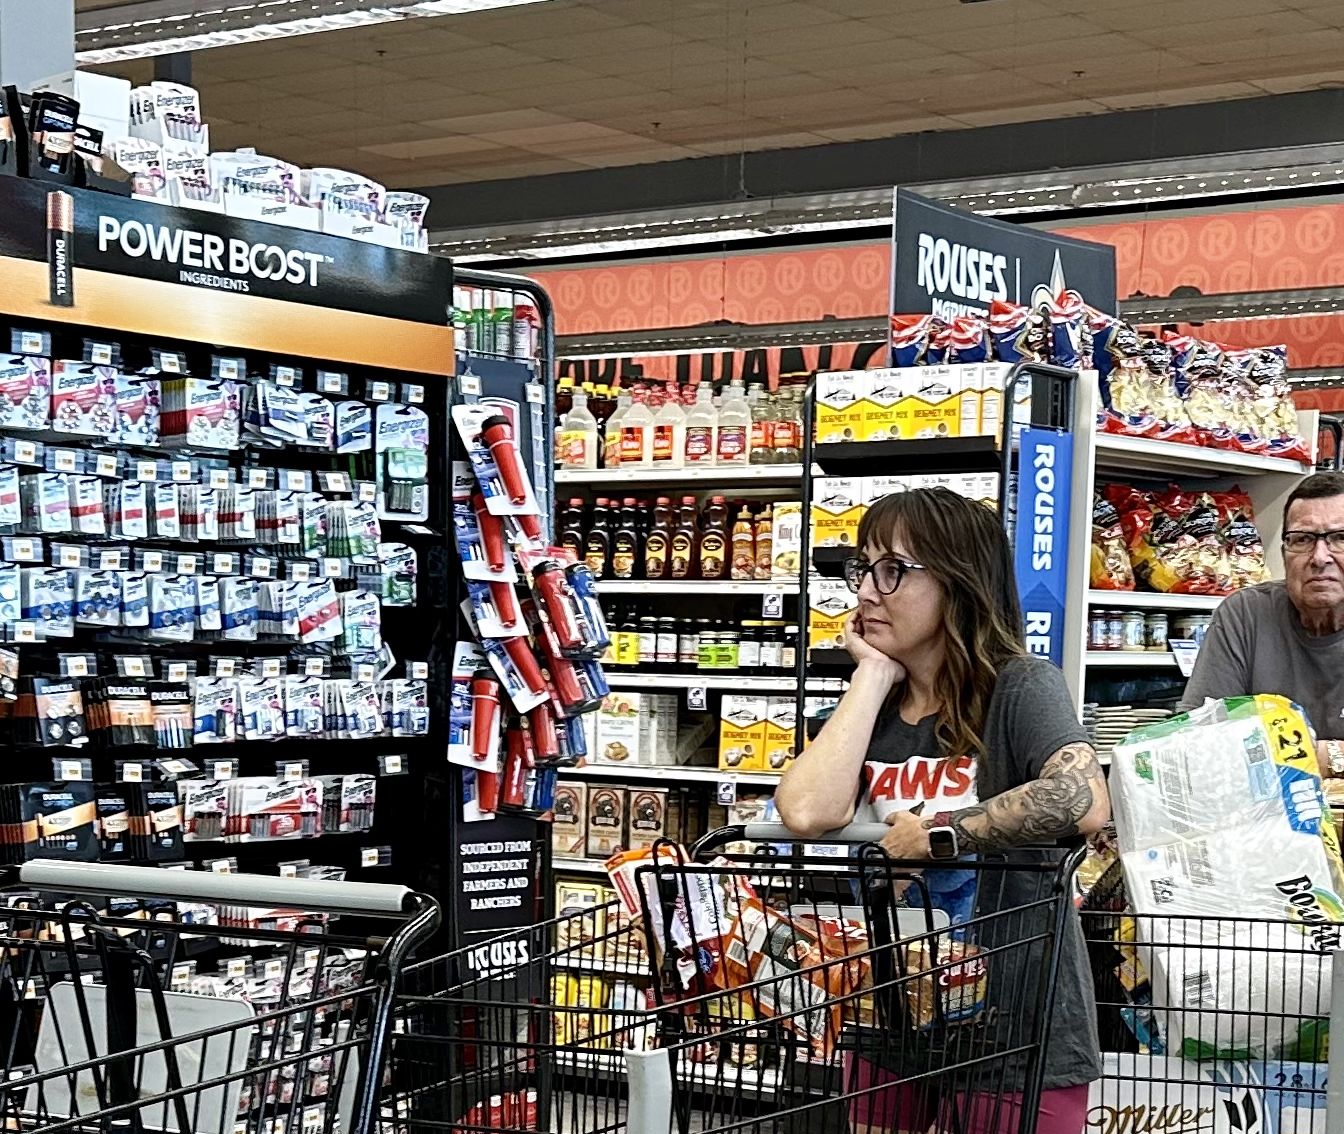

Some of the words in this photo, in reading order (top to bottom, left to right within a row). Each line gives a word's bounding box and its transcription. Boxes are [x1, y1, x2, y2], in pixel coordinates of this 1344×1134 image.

[55, 239, 67, 296] DURACELL
[98, 215, 225, 271] POWER
[229, 238, 325, 287] BOOST
[917, 232, 1008, 302] ROUSES
[179, 270, 250, 292] INGREDIENTS
[378, 417, 426, 435] Energizer
[1031, 444, 1056, 572] ROUSES
[460, 842, 503, 855] SOURCED
[504, 841, 532, 853] FROM
[462, 878, 506, 892] FARMERS
[507, 877, 529, 889] AND
